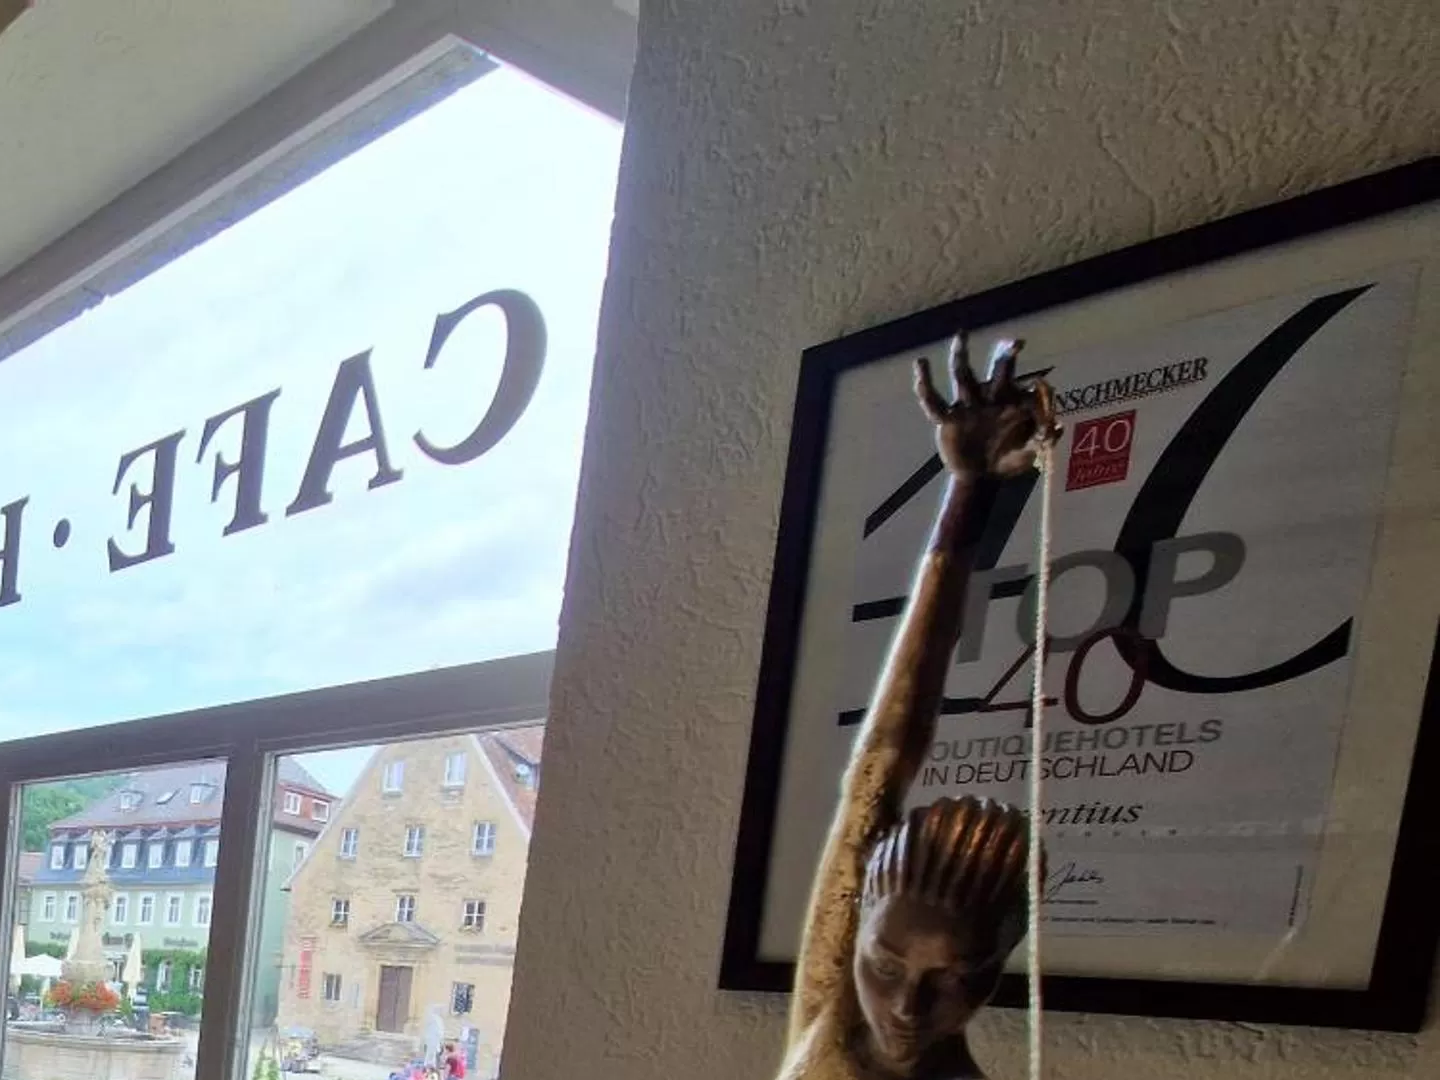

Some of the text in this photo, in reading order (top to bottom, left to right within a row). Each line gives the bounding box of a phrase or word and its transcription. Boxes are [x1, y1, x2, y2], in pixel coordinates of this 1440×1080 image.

[1054, 357, 1210, 412] NSCHMECKER
[1074, 419, 1131, 464] 40
[956, 531, 1248, 665] TOP
[978, 627, 1148, 728] 40
[928, 719, 1223, 762] OUTIQUEHOTELS
[922, 749, 1195, 787] IN DEUTSCHLAND
[1042, 801, 1144, 825] ntius
